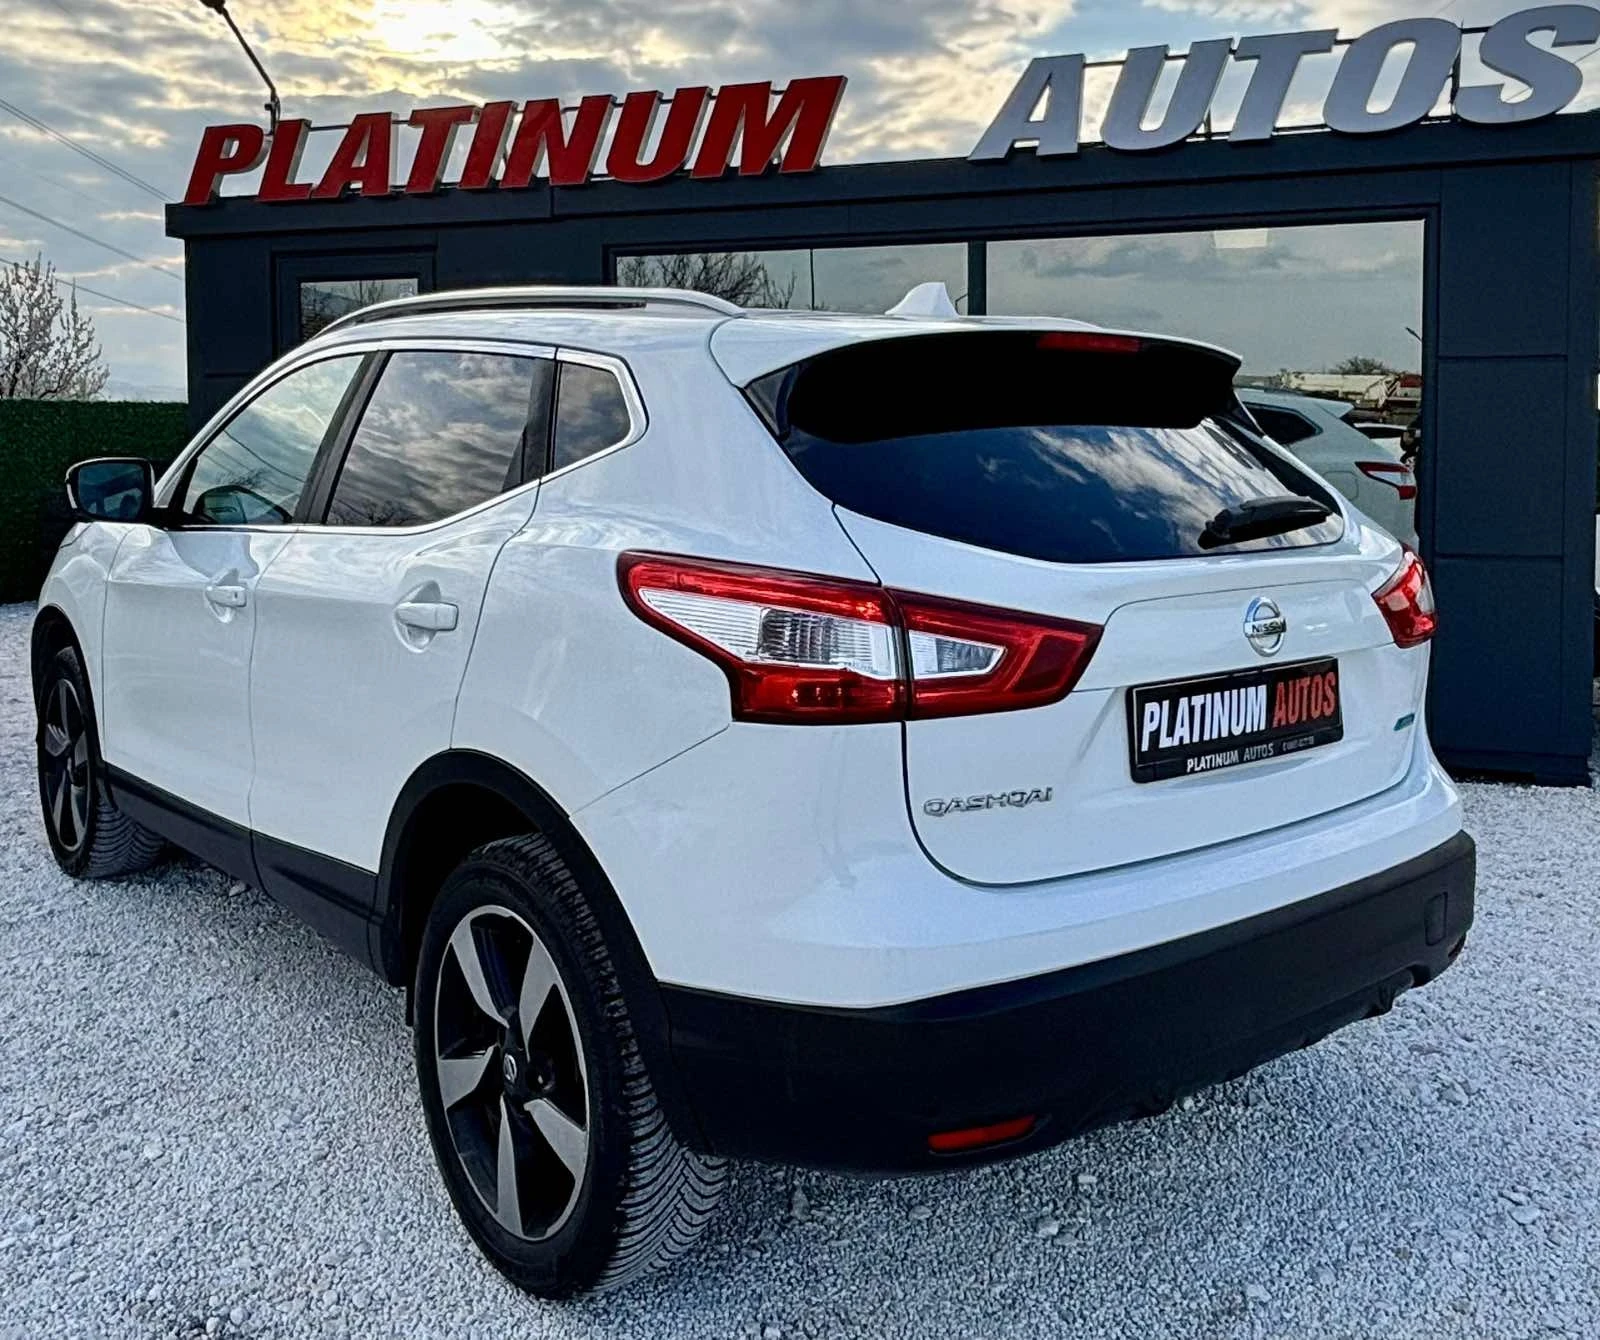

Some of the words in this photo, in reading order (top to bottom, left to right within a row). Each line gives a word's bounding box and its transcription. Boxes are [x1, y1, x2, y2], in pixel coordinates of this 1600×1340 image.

[184, 75, 848, 206] PLATINUM
[966, 4, 1600, 162] AUTOS
[1141, 684, 1267, 752] PLATINUM
[1272, 671, 1336, 728] AUTOS
[1186, 749, 1239, 773] PLATINUM
[1243, 742, 1274, 761] AUTOS
[923, 787, 1053, 817] QASHQAI
